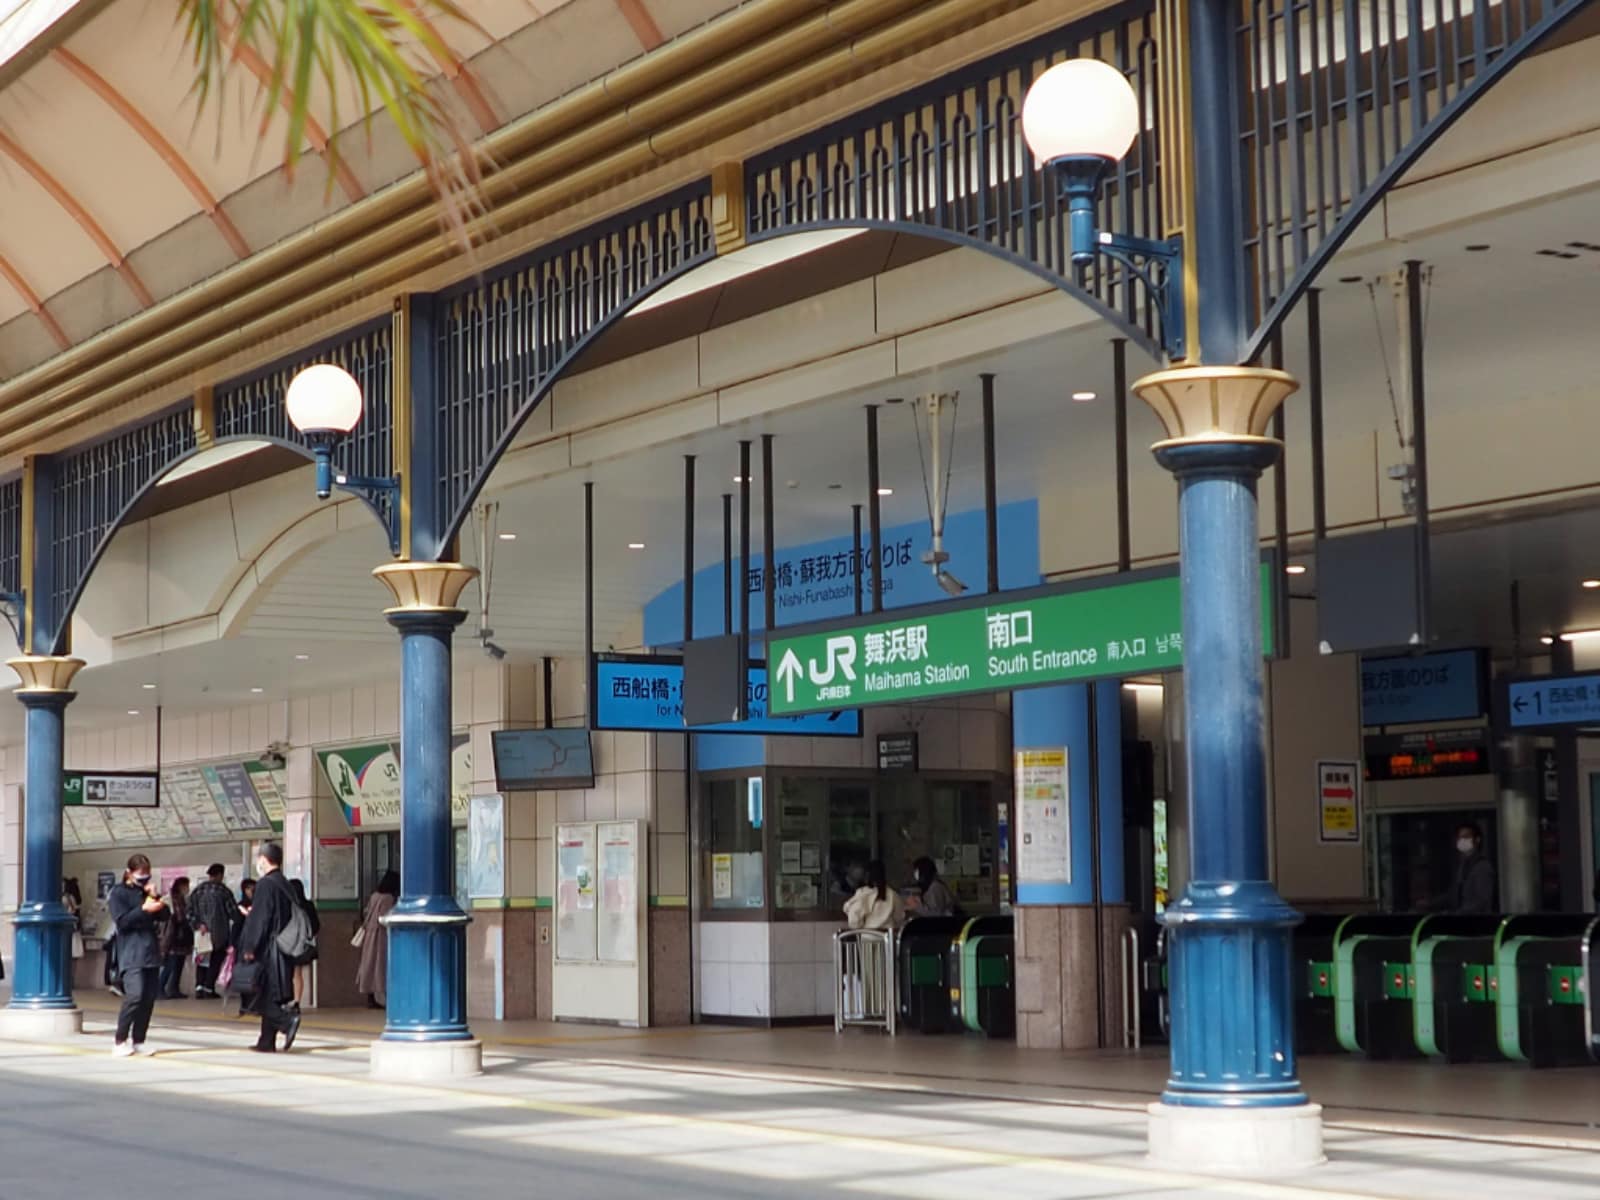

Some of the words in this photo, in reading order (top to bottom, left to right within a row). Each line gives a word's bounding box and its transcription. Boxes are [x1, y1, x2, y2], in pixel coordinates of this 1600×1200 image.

[778, 583, 855, 608] Nishi-Funabash
[987, 610, 1032, 650] 南口
[864, 625, 928, 667] 舞浜駅
[1106, 638, 1146, 662] 南入口
[809, 635, 856, 685] JR
[988, 652, 1028, 676] South
[1033, 648, 1097, 671] Entrance
[612, 677, 684, 700] 西船橋・
[864, 670, 921, 692] Maihama
[924, 662, 970, 685] Station
[656, 704, 671, 717] for
[1533, 691, 1541, 715] 1
[63, 778, 81, 791] JR
